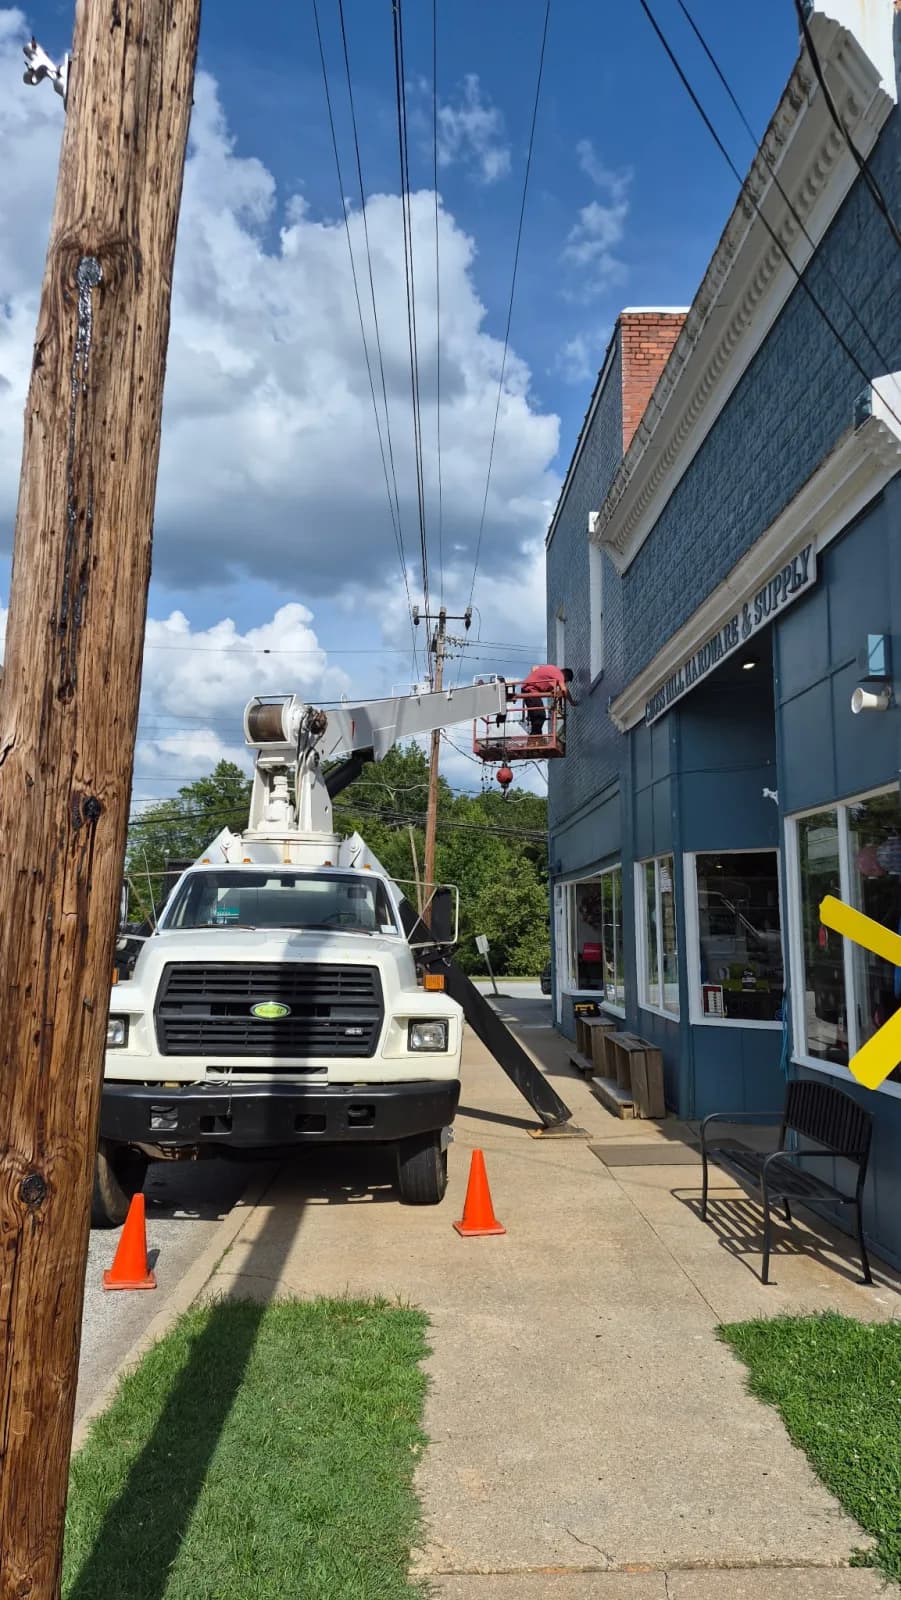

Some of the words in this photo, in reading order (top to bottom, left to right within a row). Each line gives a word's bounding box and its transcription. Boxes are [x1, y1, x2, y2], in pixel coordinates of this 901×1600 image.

[665, 668, 685, 705] HILL
[684, 614, 739, 687] HARDWARE
[741, 603, 752, 640] &
[754, 544, 812, 625] SUPPLY
